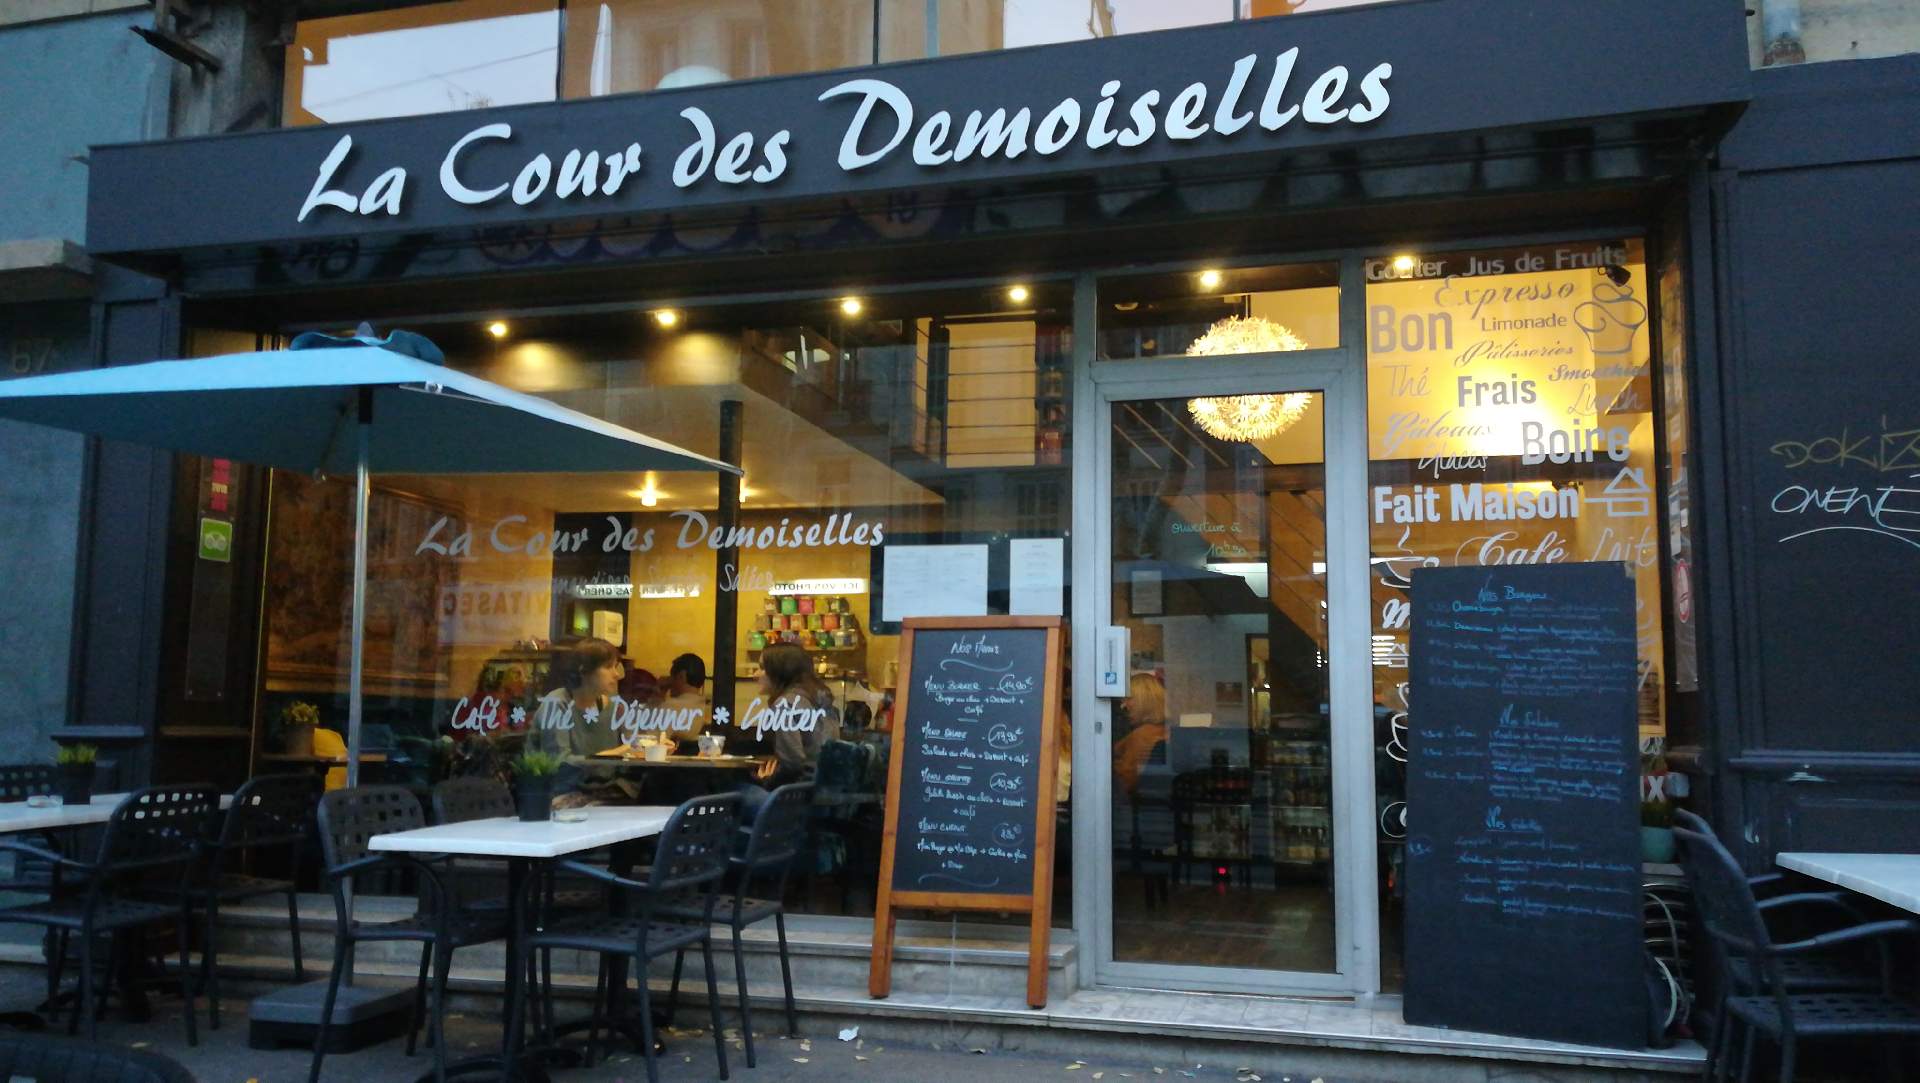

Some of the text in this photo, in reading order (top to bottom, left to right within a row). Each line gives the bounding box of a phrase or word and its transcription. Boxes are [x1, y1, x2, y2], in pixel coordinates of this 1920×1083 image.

[297, 46, 1393, 223] La Cour des Demoiselles
[1366, 246, 1627, 282] Goter Jus de Fruits
[1434, 274, 1575, 320] Expresso
[1370, 304, 1454, 354] Bon
[1481, 312, 1568, 333] Limonade
[1383, 364, 1432, 399] Thé
[1457, 373, 1537, 408] Frais
[1522, 419, 1631, 465] Boire
[1374, 481, 1580, 524] Fait Maison
[415, 509, 884, 557] La Cour des Demoiselles
[1455, 531, 1570, 567] Café
[451, 695, 827, 744] Café Thé Déjeuner Goûter
